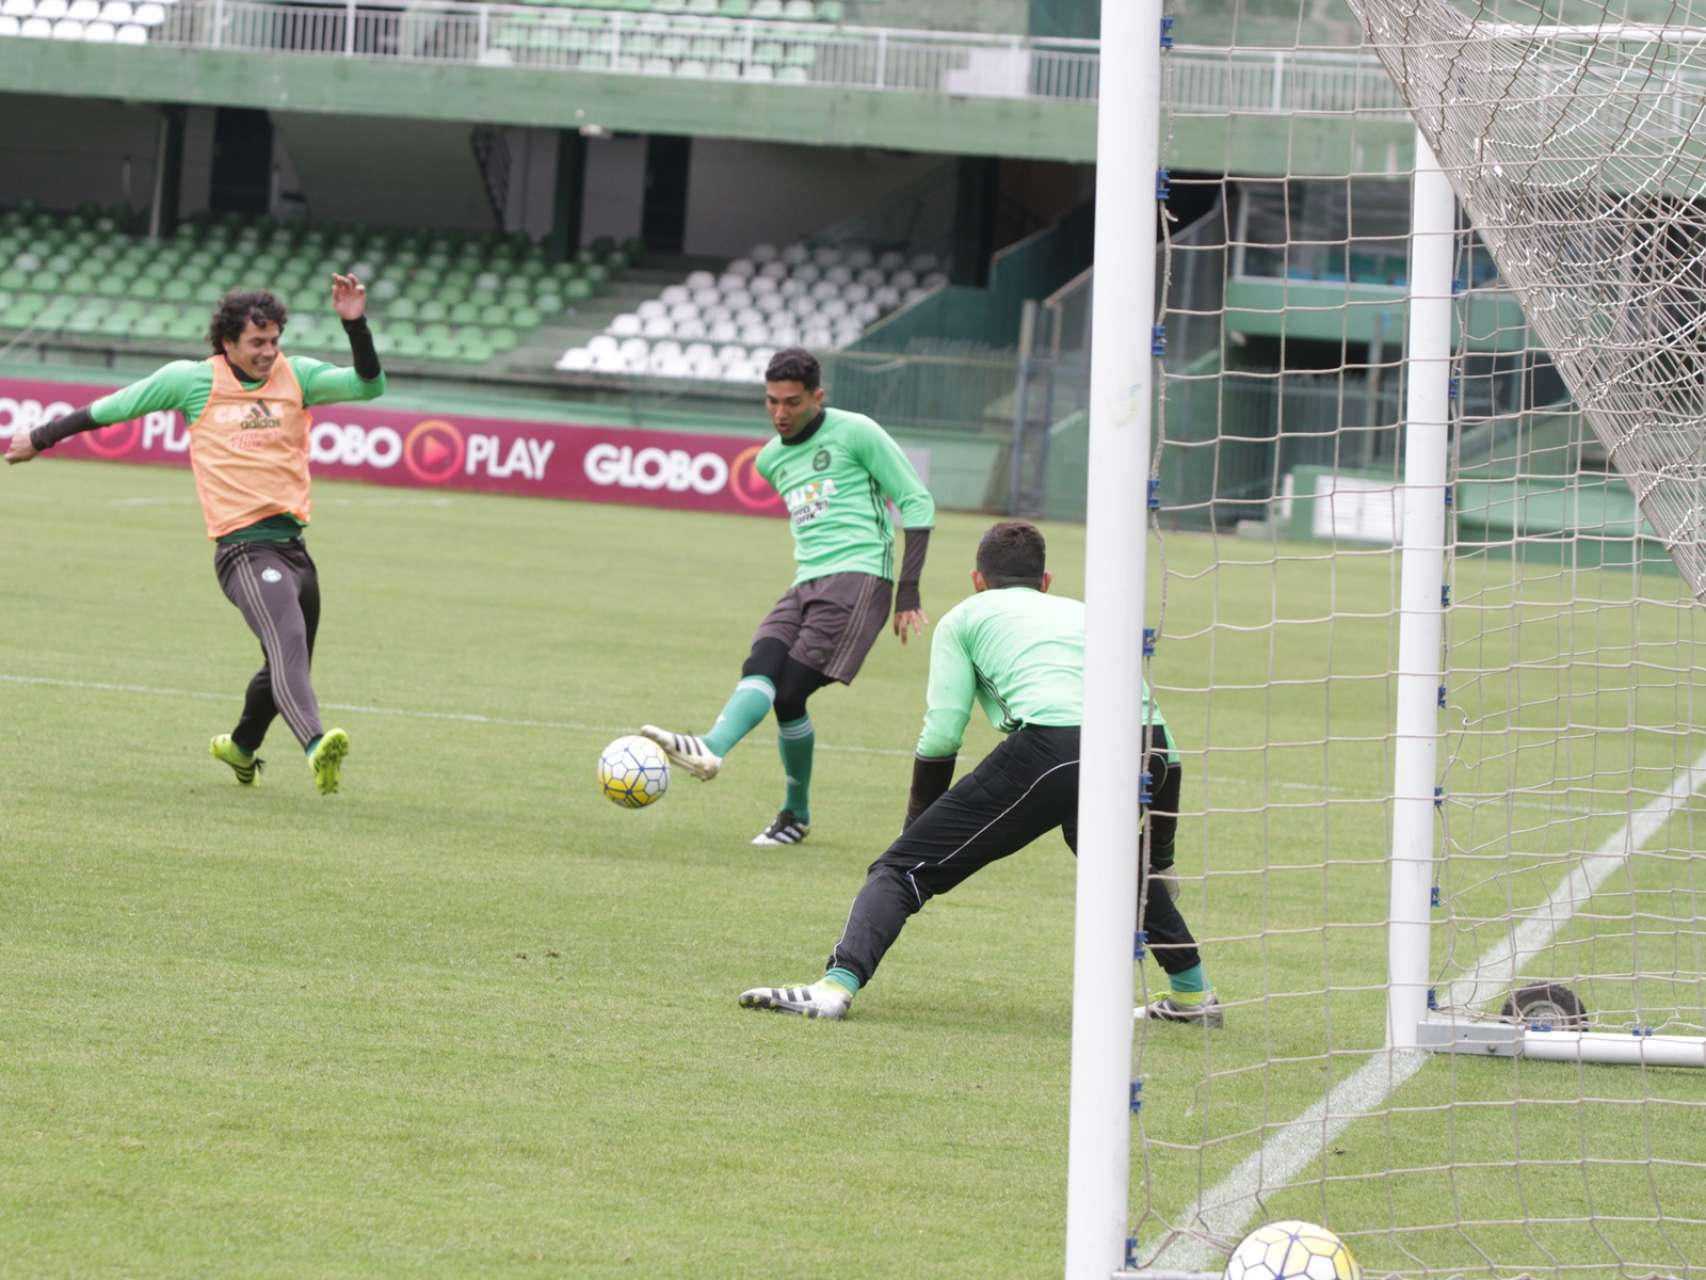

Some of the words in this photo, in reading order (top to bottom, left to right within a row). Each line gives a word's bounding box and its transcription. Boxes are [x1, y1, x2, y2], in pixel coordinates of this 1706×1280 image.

[309, 422, 402, 468] OBO
[465, 434, 555, 480] PLAY
[583, 443, 729, 495] GLOBO
